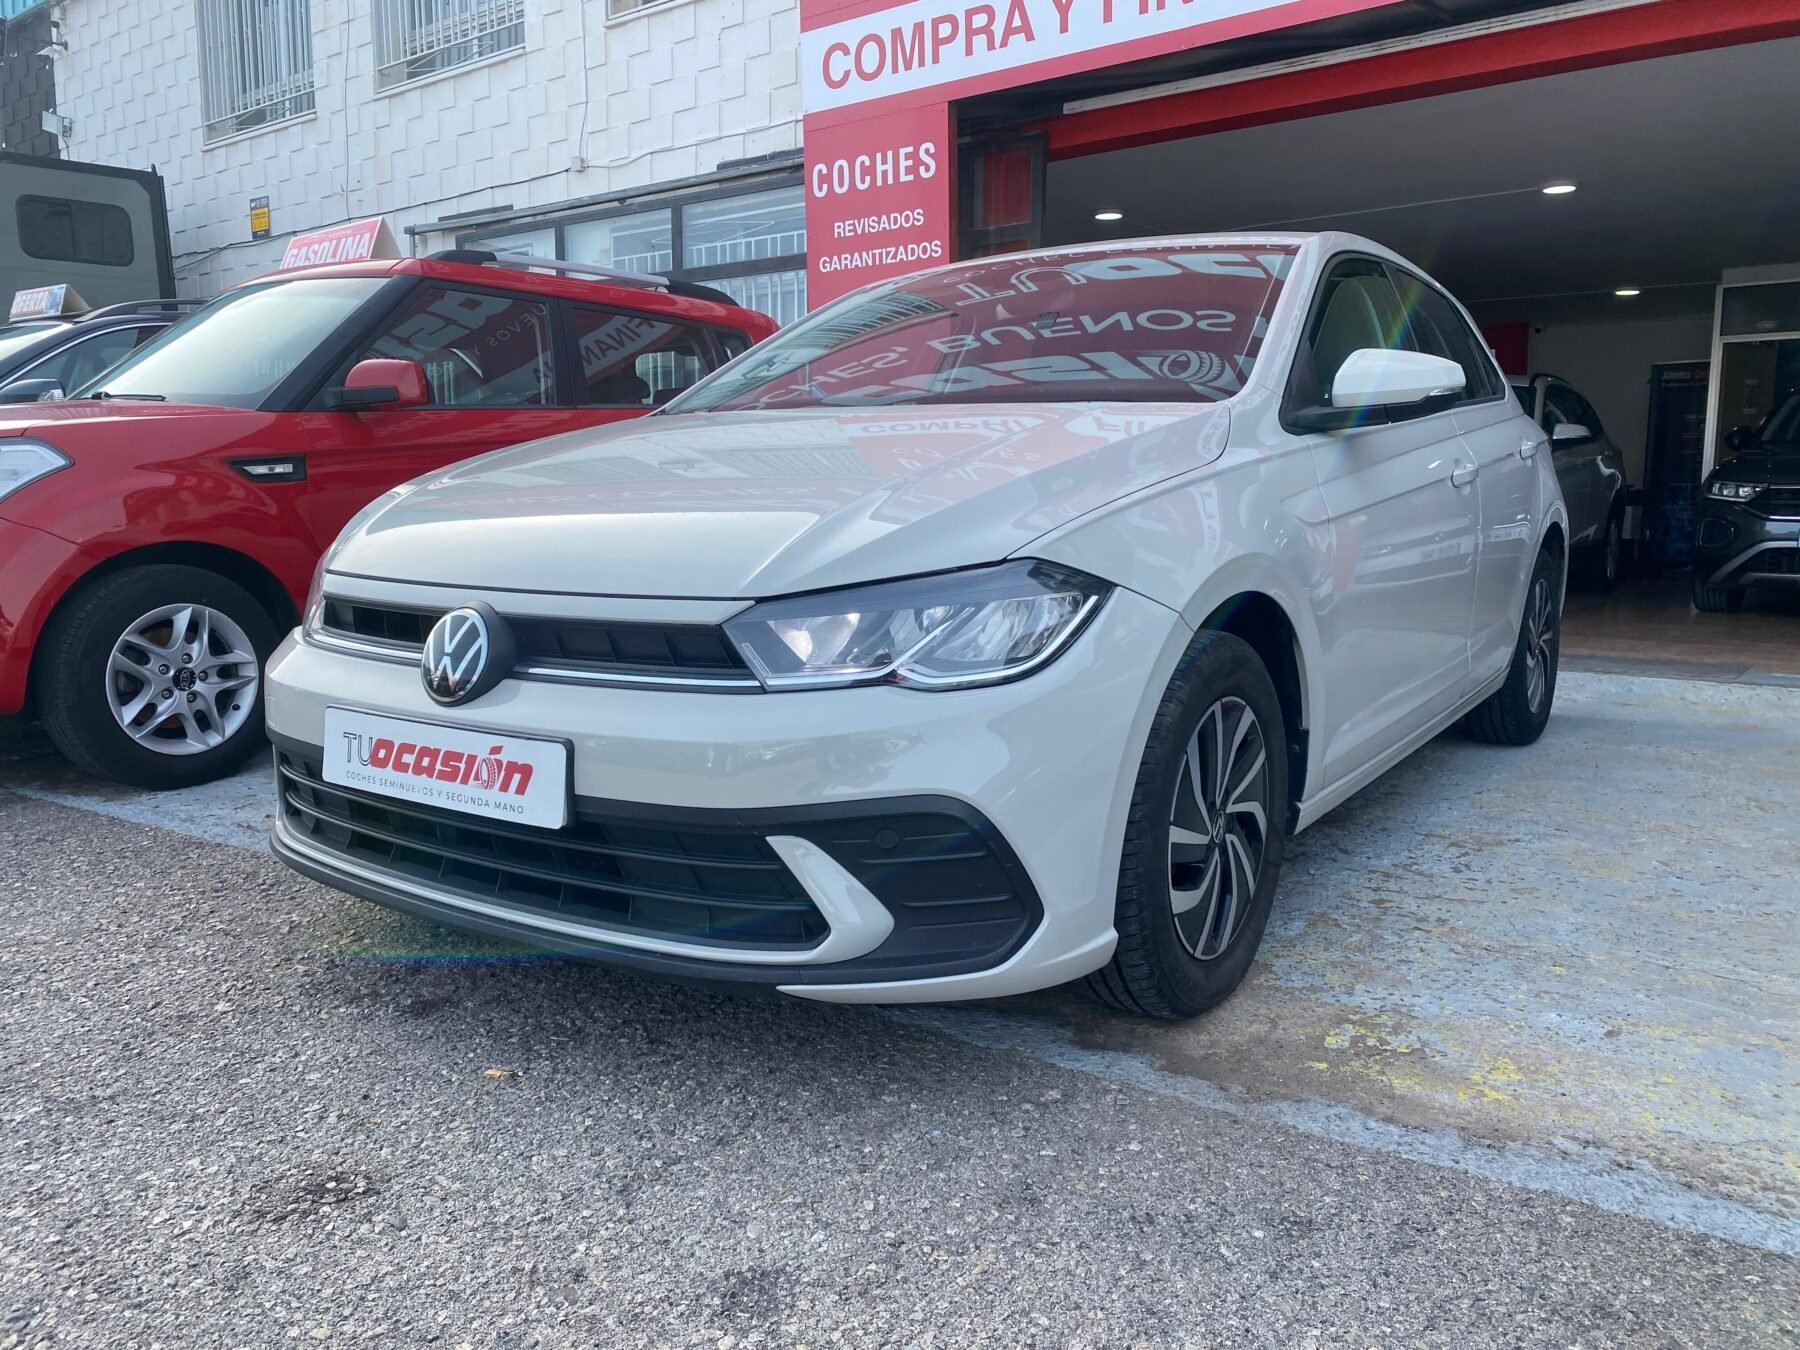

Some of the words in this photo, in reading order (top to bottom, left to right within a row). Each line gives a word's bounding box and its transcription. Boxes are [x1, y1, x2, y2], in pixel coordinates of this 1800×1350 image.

[821, 0, 1036, 90] COMPRA
[812, 141, 937, 198] COCHES
[834, 208, 925, 239] REVISADOS
[284, 232, 371, 269] GASOLINA
[819, 240, 942, 273] GARANTIZADOS
[346, 770, 376, 785] COCHES
[379, 777, 434, 797] SEMINUEVOS
[437, 789, 443, 799] Y
[445, 791, 490, 809] SEGUNDA
[494, 801, 524, 815] MANO
